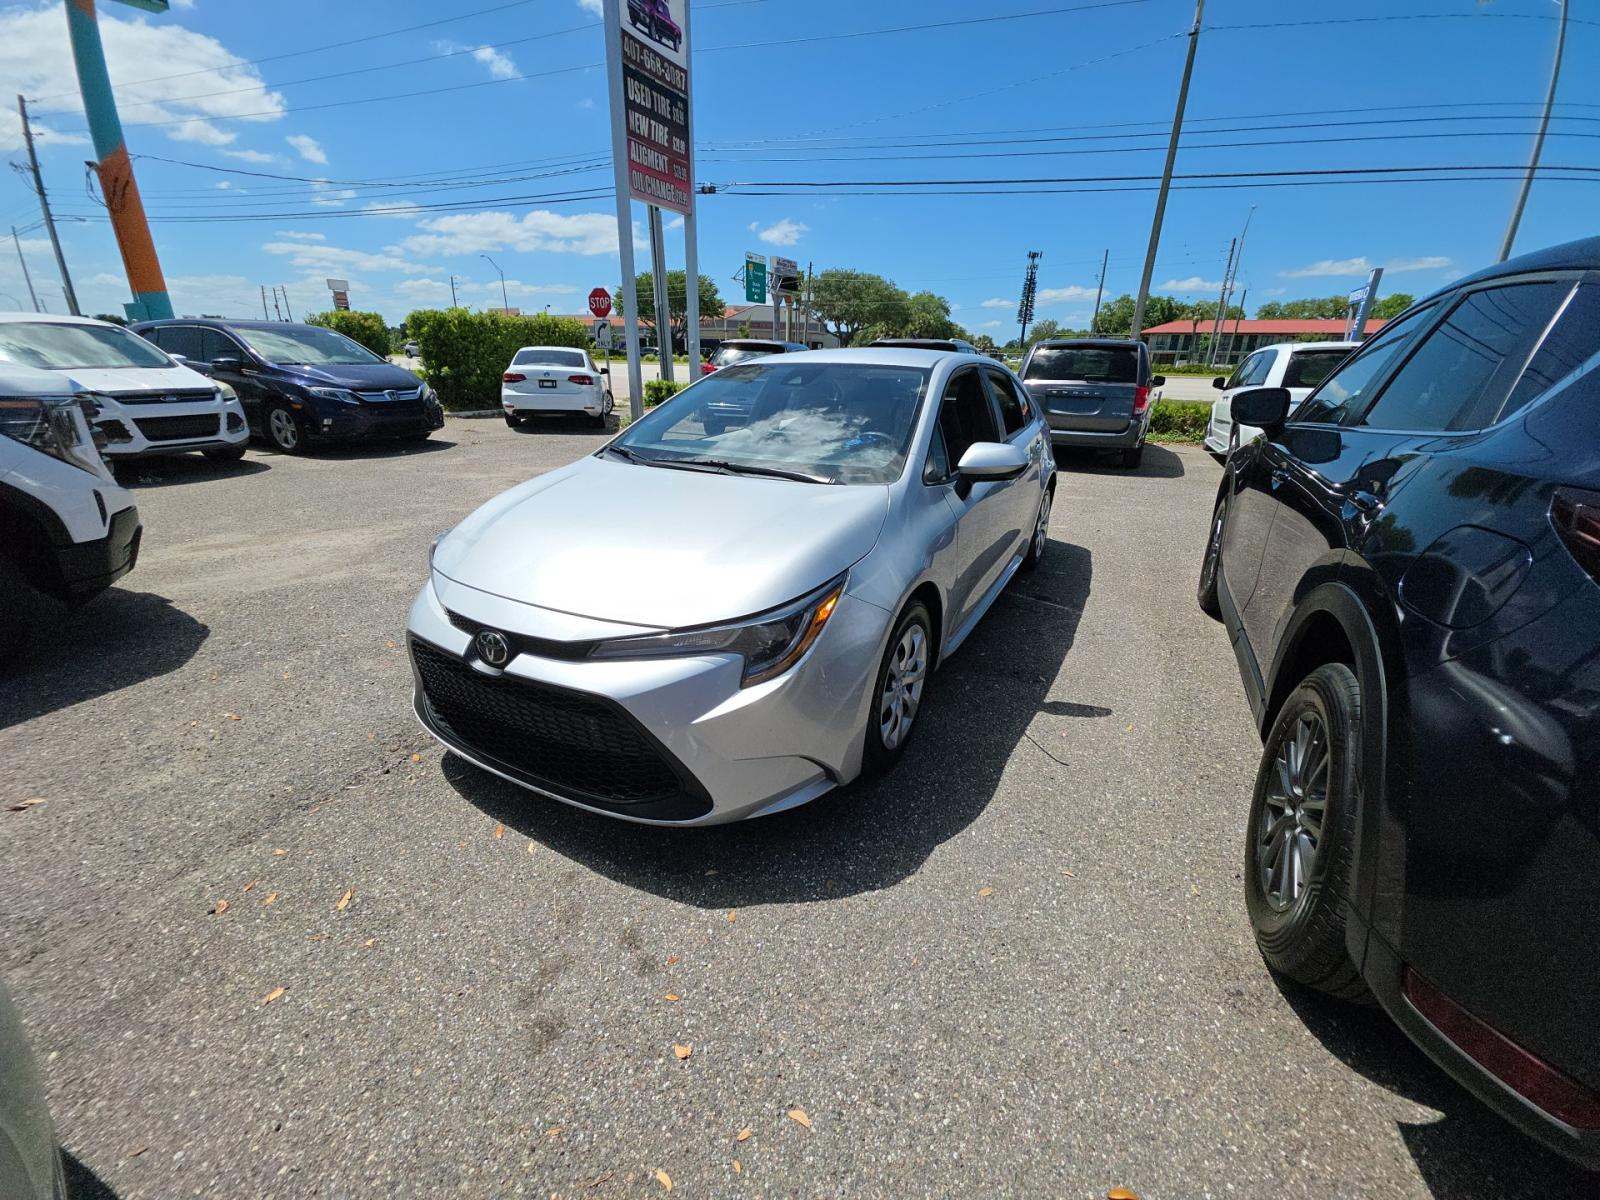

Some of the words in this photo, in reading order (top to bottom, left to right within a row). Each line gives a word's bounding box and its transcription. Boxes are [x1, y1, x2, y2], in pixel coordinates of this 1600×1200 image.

[627, 77, 652, 109] USED
[652, 92, 671, 120] TIRE
[628, 109, 649, 138] NEW
[650, 120, 669, 147] TIRE
[630, 140, 669, 174] ALIGMENT
[632, 169, 645, 191] OIL
[645, 174, 675, 202] CHANGE
[590, 297, 610, 309] STOP
